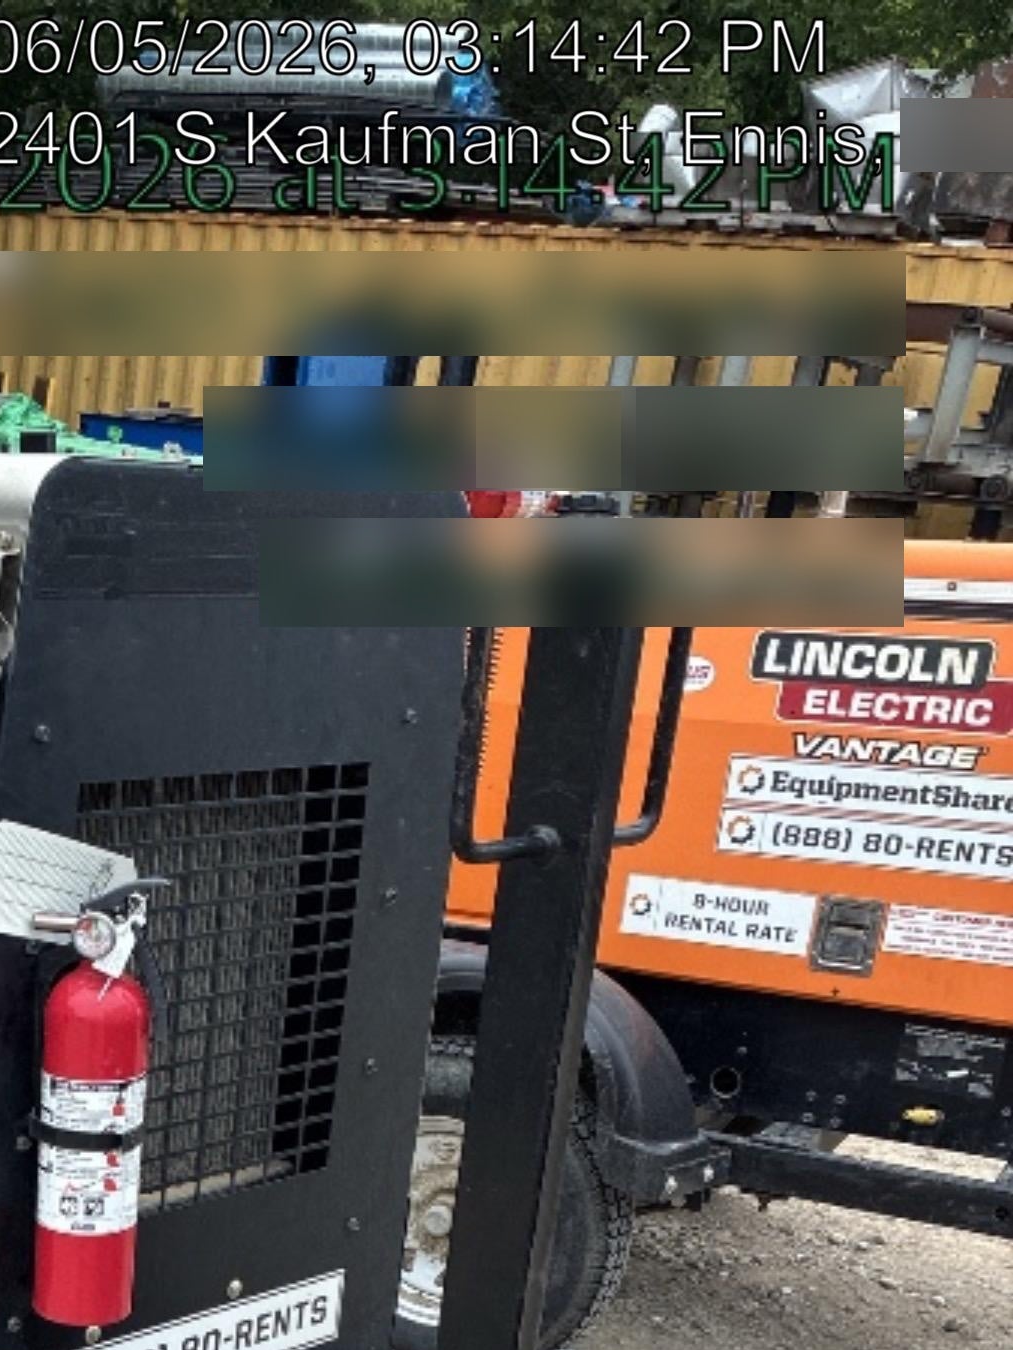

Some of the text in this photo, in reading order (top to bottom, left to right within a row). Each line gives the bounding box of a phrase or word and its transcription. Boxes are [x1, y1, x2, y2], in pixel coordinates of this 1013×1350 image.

[762, 638, 980, 686] LINCOLN
[802, 688, 994, 727] ELECTRIC
[793, 733, 983, 771] VANTAGE
[771, 820, 1013, 868] (888) 80-RENTS
[693, 893, 771, 917] 8-HOUR
[663, 910, 798, 943] RENTAL RATE
